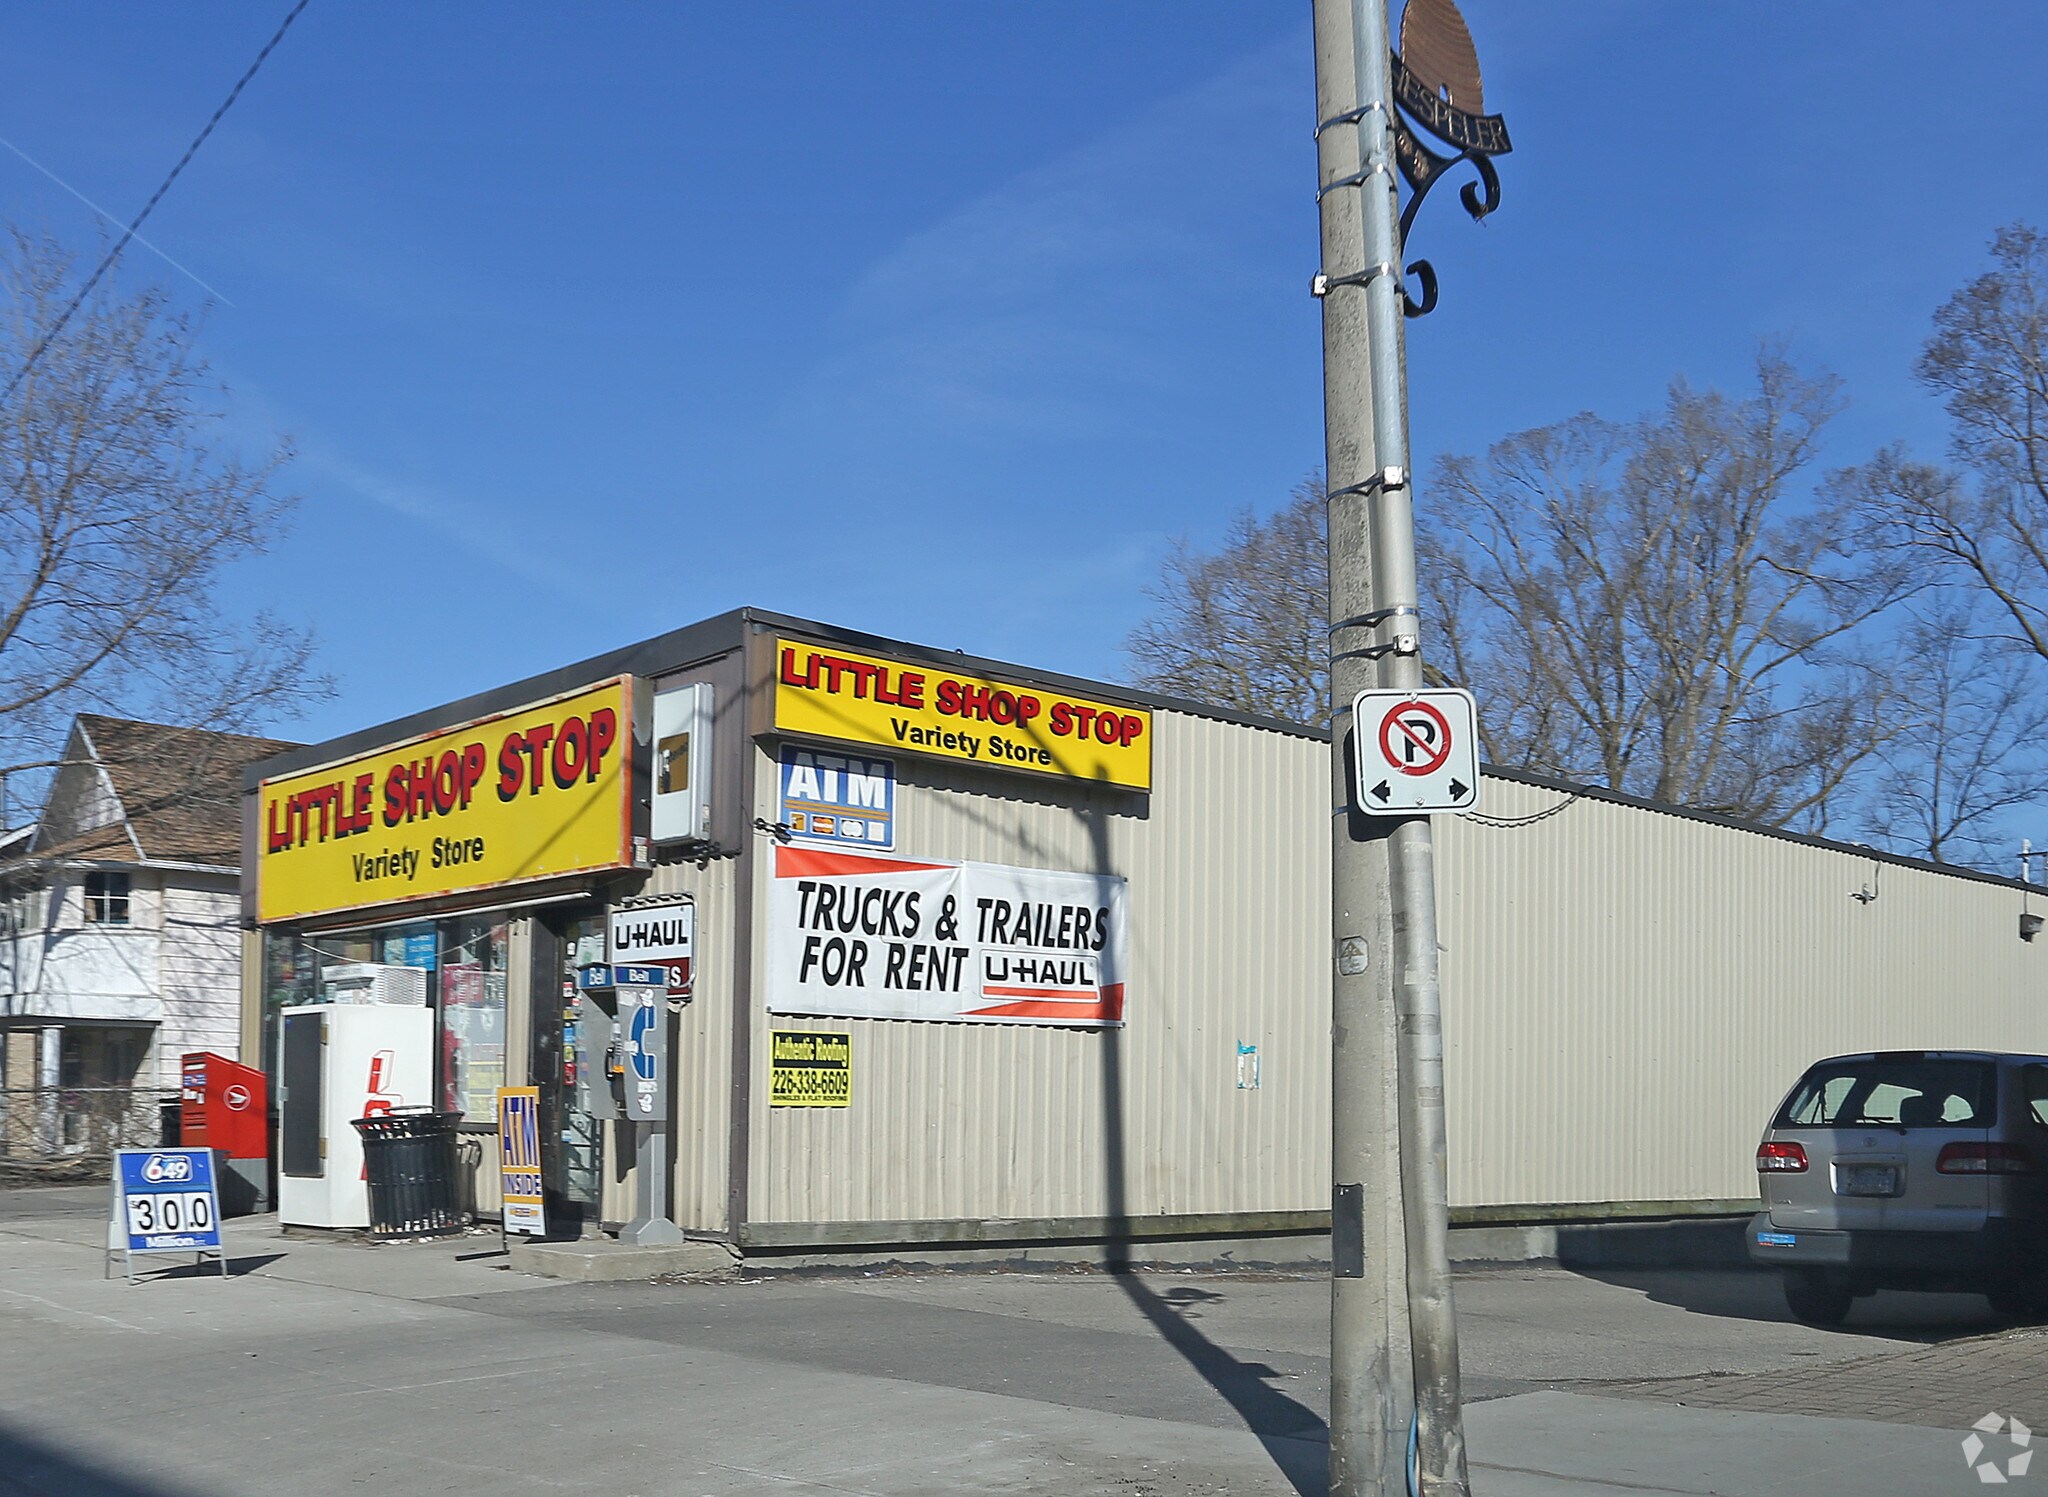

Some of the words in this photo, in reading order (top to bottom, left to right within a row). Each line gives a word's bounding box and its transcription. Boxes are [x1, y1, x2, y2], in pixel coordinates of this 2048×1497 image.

[780, 647, 925, 710] LITTLE
[936, 680, 1041, 731] SHOP
[1050, 702, 1143, 748] STOP
[891, 717, 980, 759] Variety
[988, 735, 1052, 766] Store
[268, 772, 374, 854] LITTLE
[383, 742, 486, 828] SHOP
[497, 707, 616, 803] STOP
[786, 753, 886, 810] ATM
[353, 848, 419, 882] Variety
[431, 835, 485, 869] Store
[615, 920, 688, 950] U-HAUL
[797, 880, 921, 941] TRUCKS
[935, 894, 959, 942] &
[976, 898, 1110, 953] TRAILERS
[628, 969, 650, 983] Bell
[799, 936, 869, 988] FOR
[884, 943, 969, 993] RENT
[985, 955, 1095, 986] U-HAUL
[816, 1037, 847, 1067] Roofing
[773, 1070, 848, 1094] 226-338-6609
[502, 1096, 540, 1167] ATM
[503, 1173, 542, 1196] INSIDE
